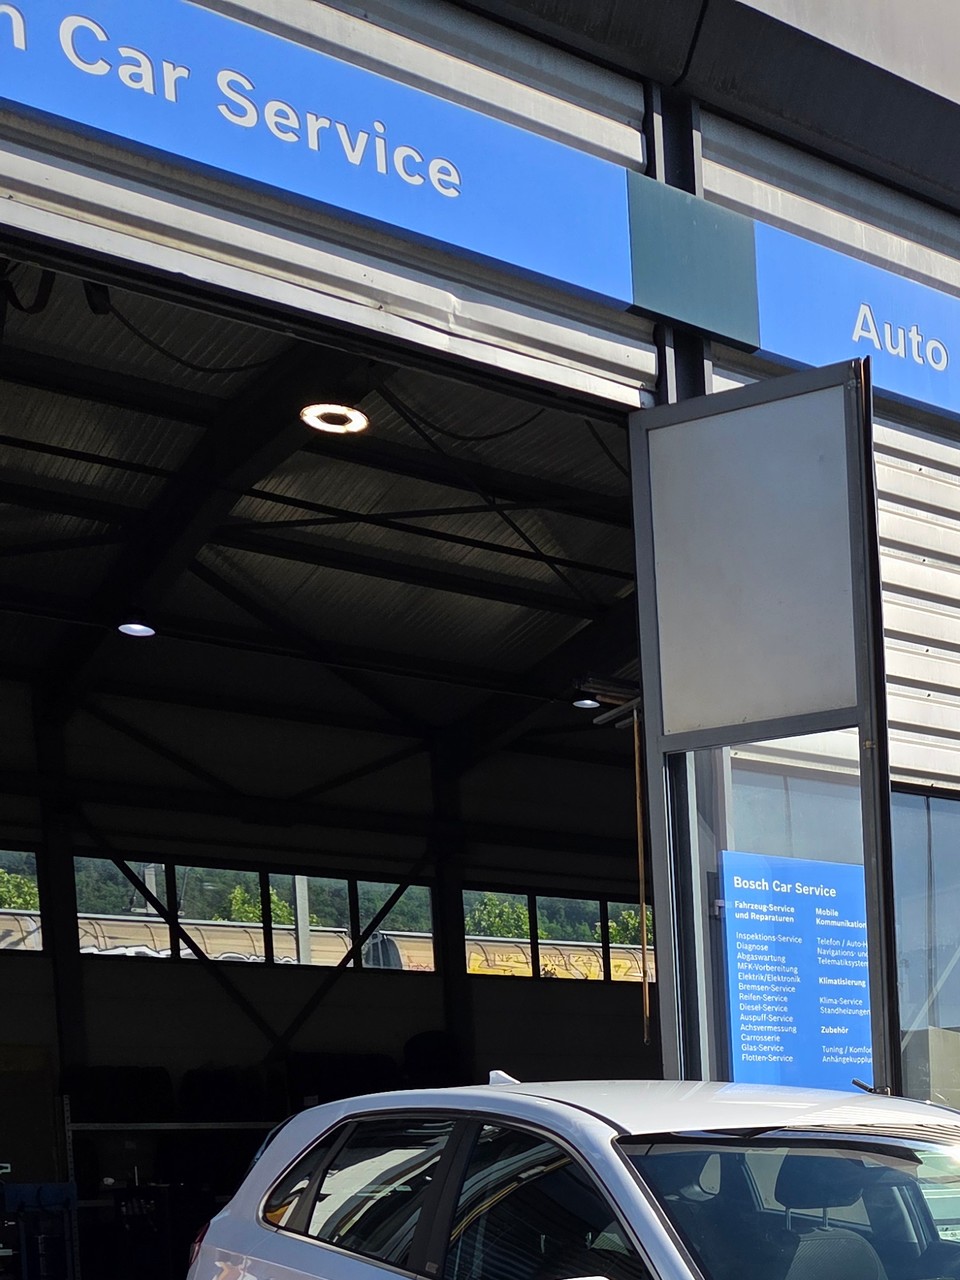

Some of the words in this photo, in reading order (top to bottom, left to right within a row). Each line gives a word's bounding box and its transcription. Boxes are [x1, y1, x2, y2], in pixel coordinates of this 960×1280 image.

[59, 15, 190, 102] Car
[216, 69, 463, 199] Service
[852, 302, 949, 371] Auto
[733, 876, 769, 891] Bosch
[772, 880, 792, 893] Car
[795, 882, 837, 897] Service
[734, 900, 795, 913] Fahrzeug-Service
[815, 907, 839, 917] Mobile
[735, 912, 749, 920] und
[750, 913, 794, 923] Reparaturen
[736, 932, 802, 944] Inspektions-Service
[817, 938, 840, 947] Telefon
[736, 942, 769, 952] Diagnose
[737, 952, 786, 963] Abgaswartung
[737, 962, 798, 974] MFK-Vorbereitung
[738, 973, 801, 983] Elektrik/Elektronik
[819, 977, 867, 987] Klimatisierung
[738, 983, 796, 993] Bremsen-Service
[739, 993, 788, 1003] Reifen-Service
[819, 997, 863, 1006] Klima-Service
[740, 1003, 789, 1013] Diesel-Service
[740, 1013, 794, 1023] Auspuff-Service
[740, 1023, 797, 1034] Achsvermessung
[821, 1026, 849, 1034] Zubehör
[741, 1034, 781, 1042] Carrosserie
[741, 1043, 784, 1053] Glas-Service
[822, 1045, 843, 1054] Tuning
[741, 1053, 793, 1063] Flotten-Service
